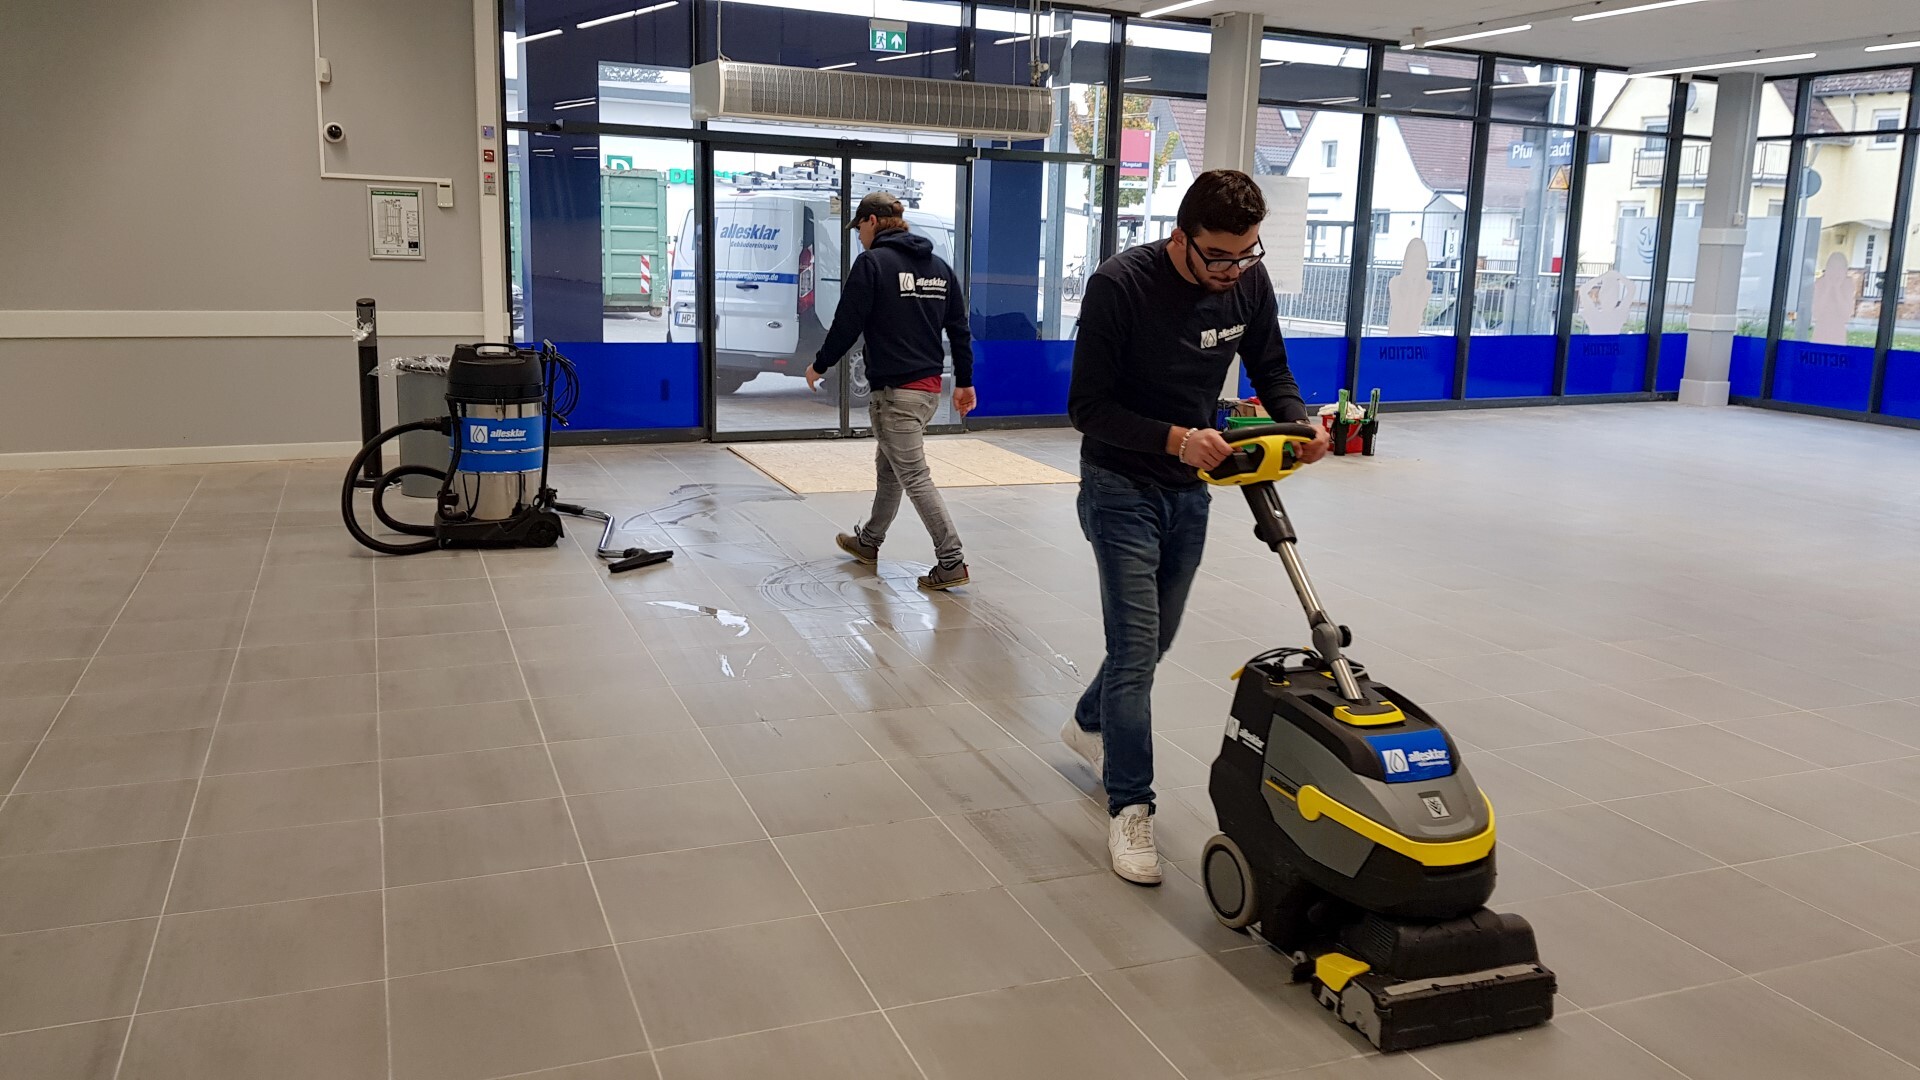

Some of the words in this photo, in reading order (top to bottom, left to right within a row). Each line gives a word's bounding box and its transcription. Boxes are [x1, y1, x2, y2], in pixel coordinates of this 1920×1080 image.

[720, 223, 780, 241] allesklar
[916, 277, 948, 288] allesklar
[490, 429, 527, 438] allesklar
